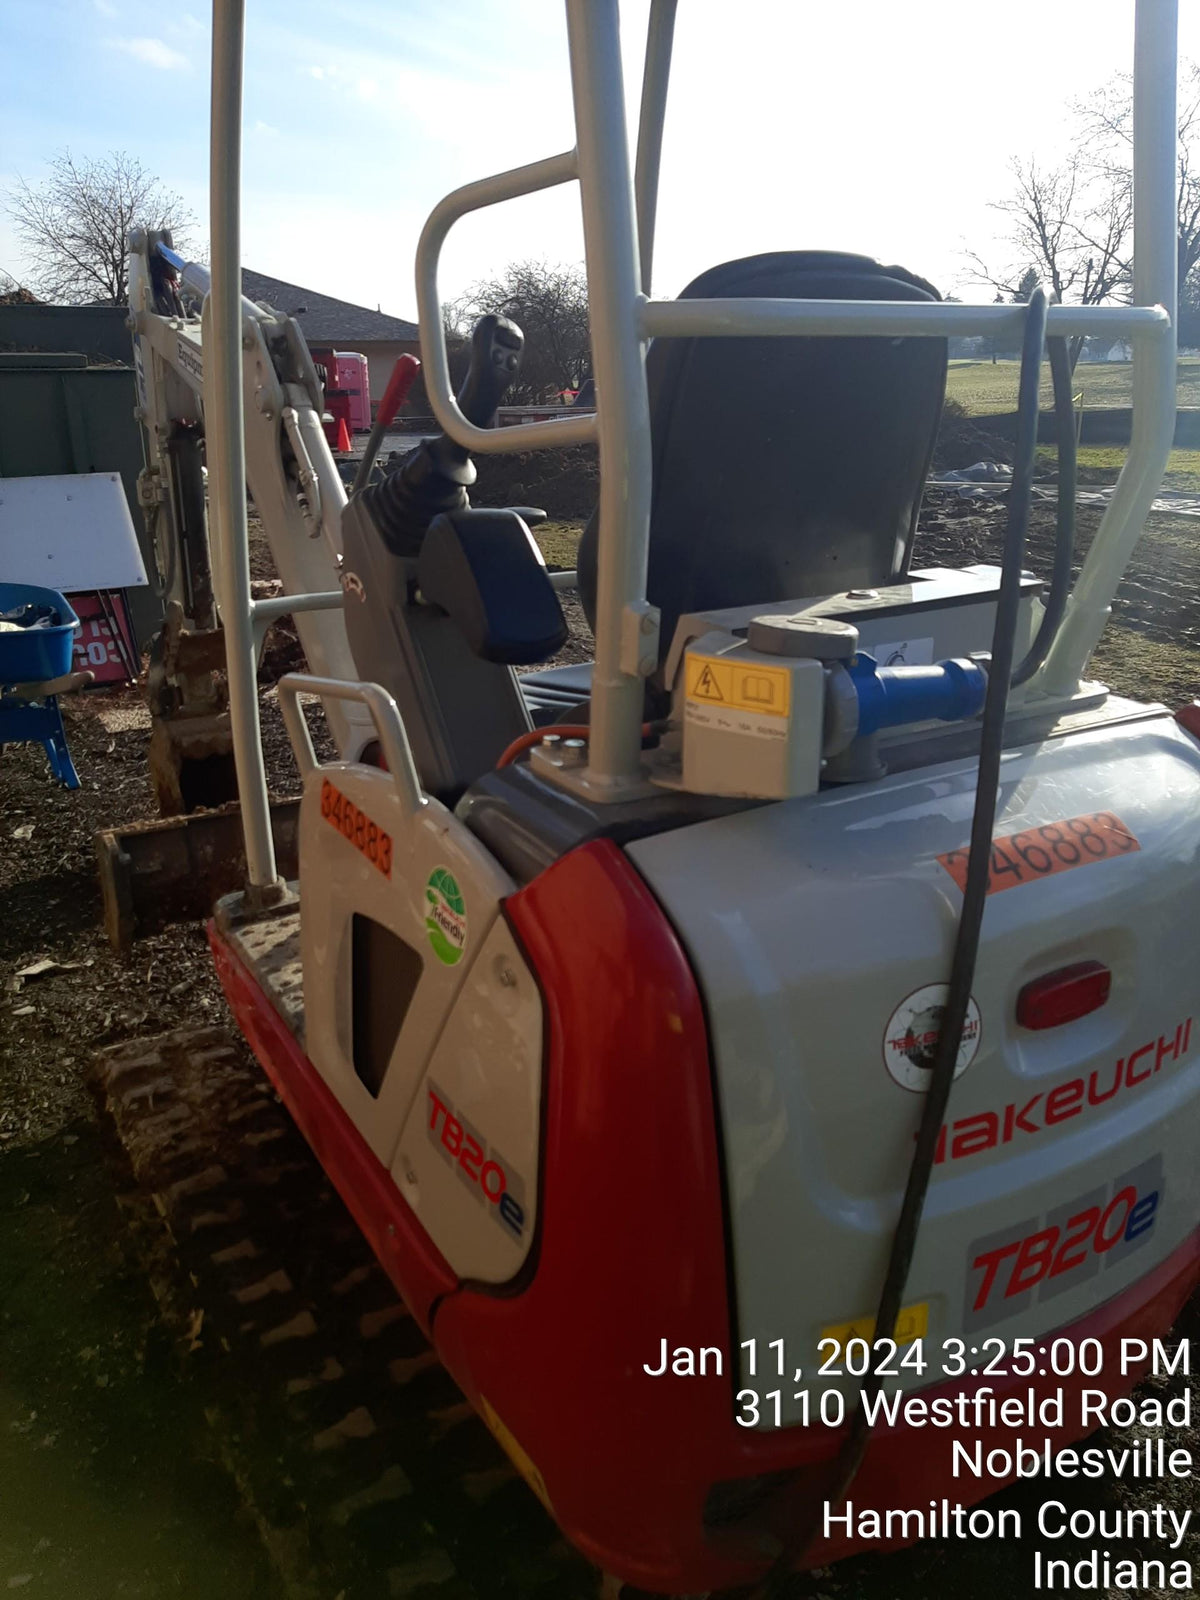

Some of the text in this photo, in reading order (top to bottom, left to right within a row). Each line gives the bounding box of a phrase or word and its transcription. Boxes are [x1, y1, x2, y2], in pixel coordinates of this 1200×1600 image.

[322, 779, 392, 876] 346883
[429, 1090, 524, 1237] TB20e
[972, 1185, 1160, 1313] TB20e
